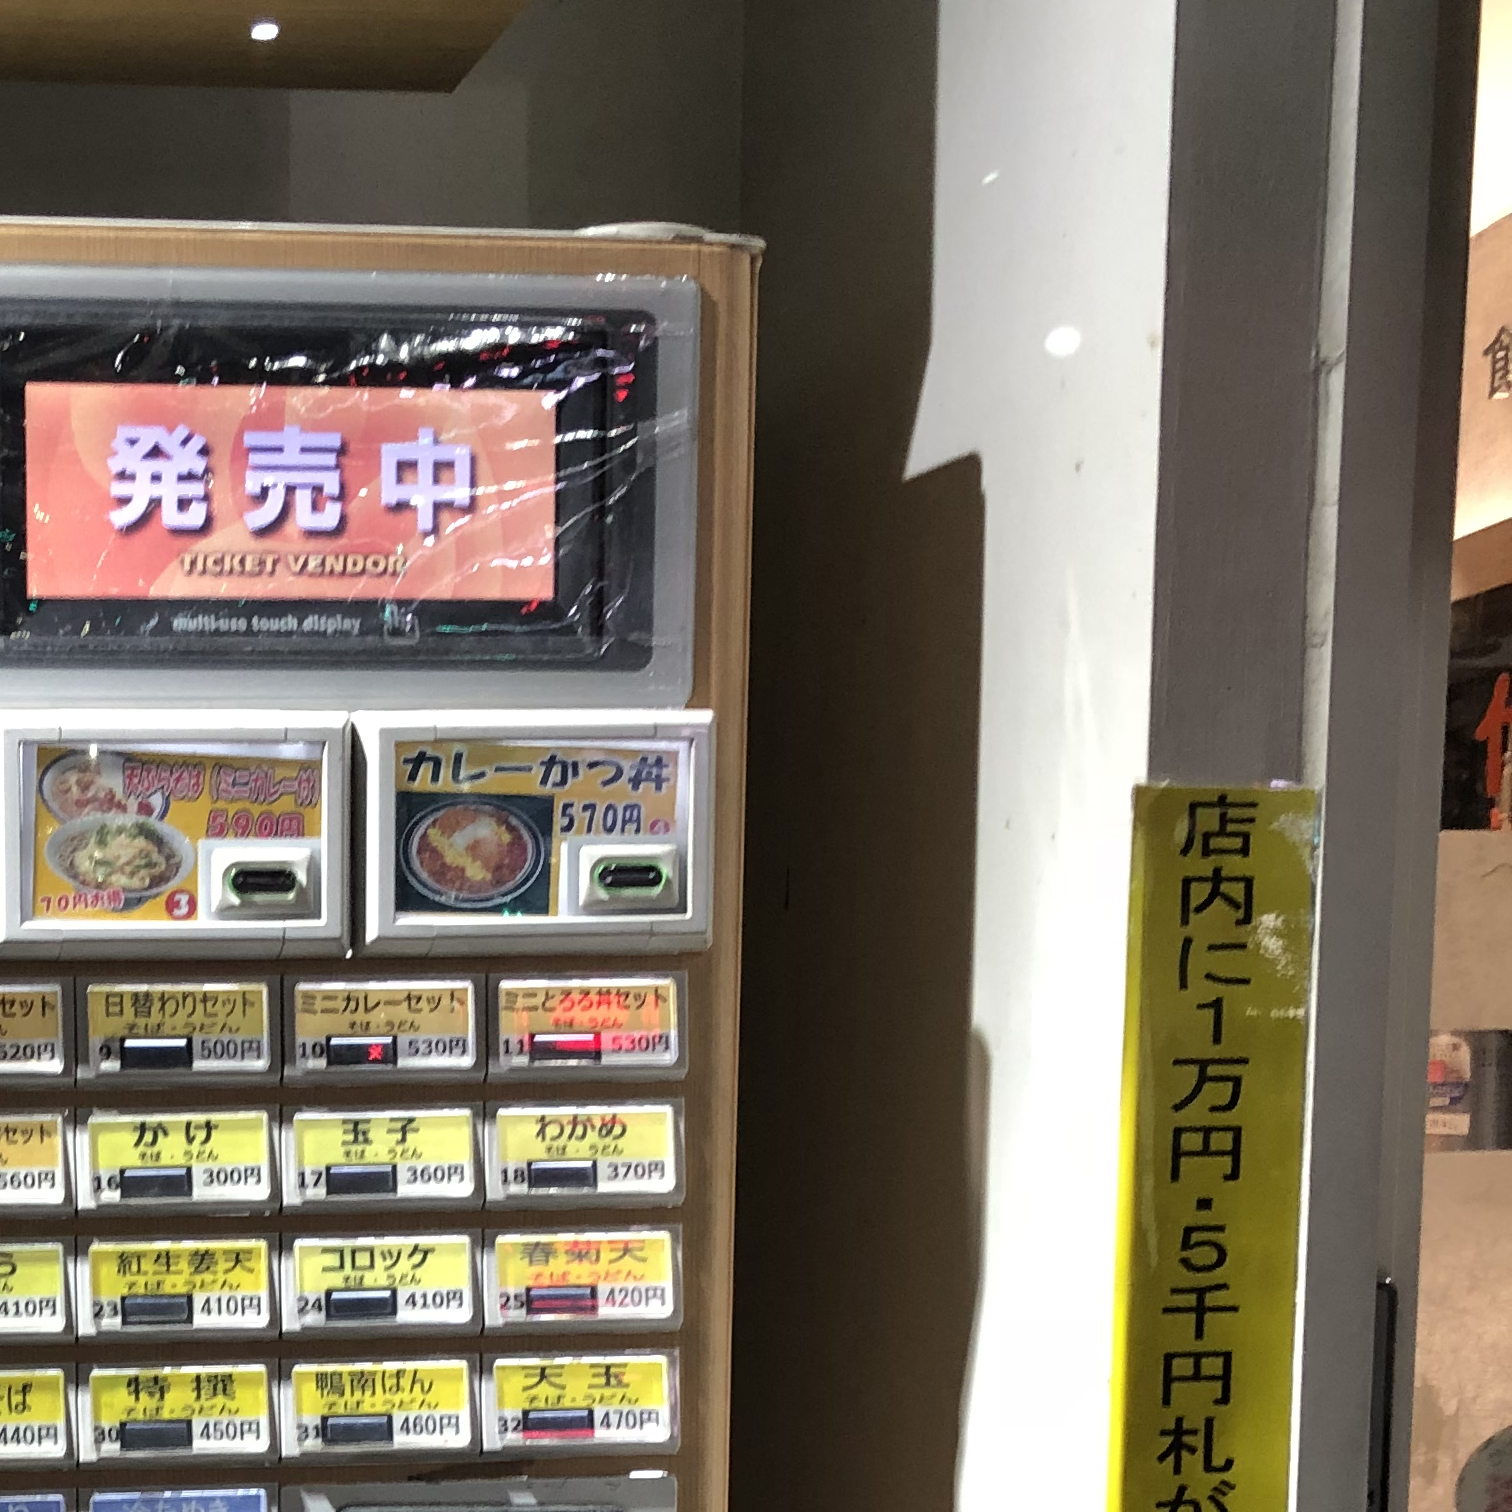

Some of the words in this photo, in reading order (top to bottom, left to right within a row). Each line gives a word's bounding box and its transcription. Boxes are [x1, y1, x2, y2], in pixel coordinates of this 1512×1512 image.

[108, 423, 477, 536] 発売中
[179, 553, 281, 576] TICKET
[288, 554, 406, 577] VENDOR
[172, 614, 247, 632] multi-use
[251, 614, 297, 632] touch
[302, 614, 361, 634] display
[402, 750, 669, 792] カレーかつ丼
[207, 810, 304, 839] 590円
[559, 802, 641, 835] 570円
[104, 992, 255, 1019] 日替わりセット
[300, 990, 463, 1015] ミニカレーセット
[200, 1039, 261, 1060] 500円
[298, 1044, 325, 1060] 10
[408, 1038, 467, 1056] 530円
[612, 1035, 670, 1052] 530円
[133, 1120, 219, 1148] かけ
[342, 1118, 420, 1148] 玉子
[535, 1116, 628, 1142] わかめ
[94, 1174, 120, 1191] 16
[202, 1168, 261, 1186] 300円
[298, 1171, 322, 1188] 17
[407, 1166, 465, 1184] 360円
[608, 1162, 665, 1181] 370円
[118, 1249, 255, 1277] 紅生姜天
[321, 1244, 436, 1273] コロッケ
[521, 1241, 648, 1266] 春菊天
[201, 1296, 261, 1317] 410円
[405, 1290, 463, 1310] 410円
[605, 1287, 665, 1307] 420円
[316, 1370, 433, 1398] 鴨南ばん
[522, 1365, 630, 1391] 天玉
[200, 1420, 260, 1441] 450円
[400, 1415, 460, 1436] 460円
[600, 1410, 660, 1430] 470円
